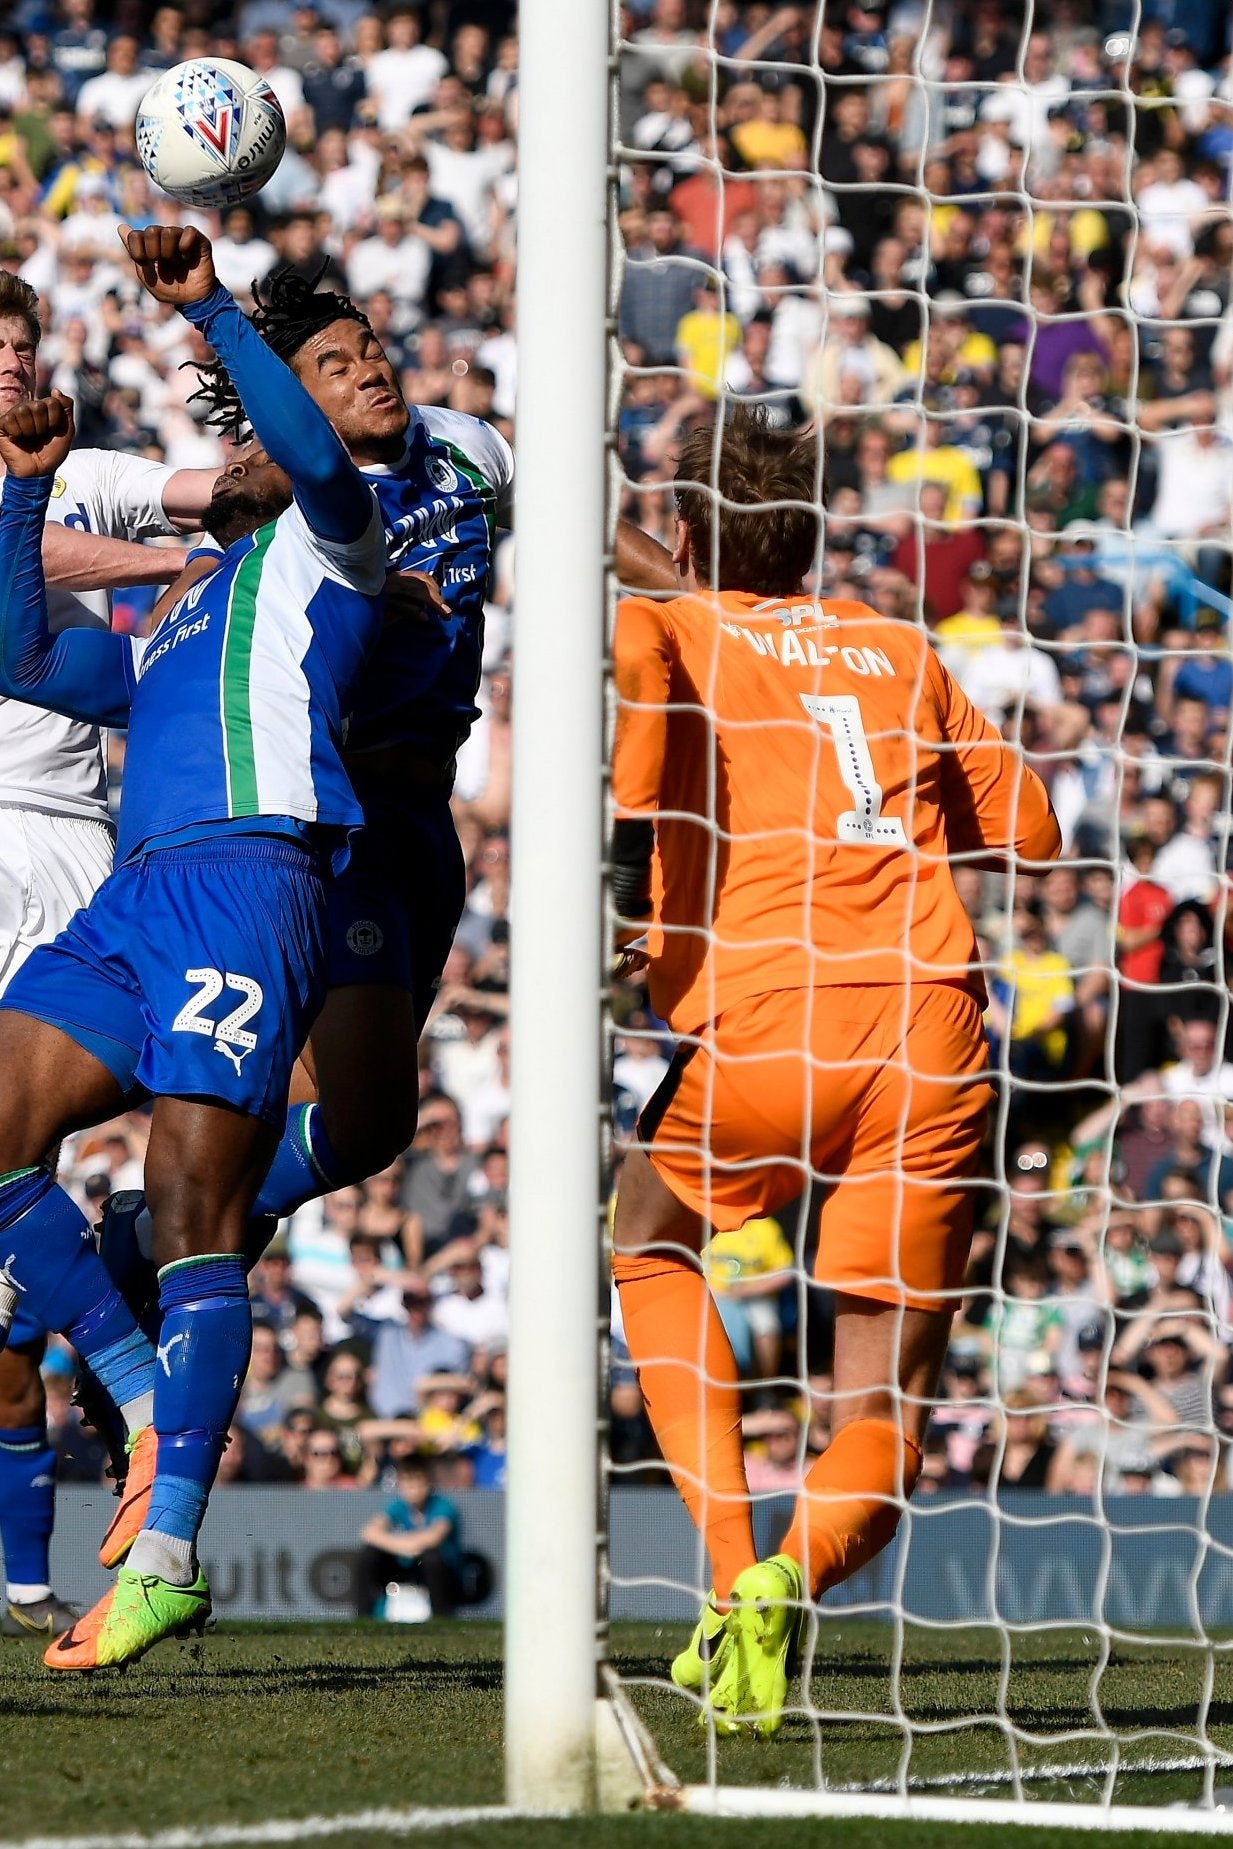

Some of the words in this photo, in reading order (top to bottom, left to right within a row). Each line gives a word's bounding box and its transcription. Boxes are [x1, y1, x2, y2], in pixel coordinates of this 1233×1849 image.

[172, 612, 211, 649] First
[741, 628, 897, 677] WALON
[799, 692, 909, 846] 1
[171, 967, 264, 1050] 22
